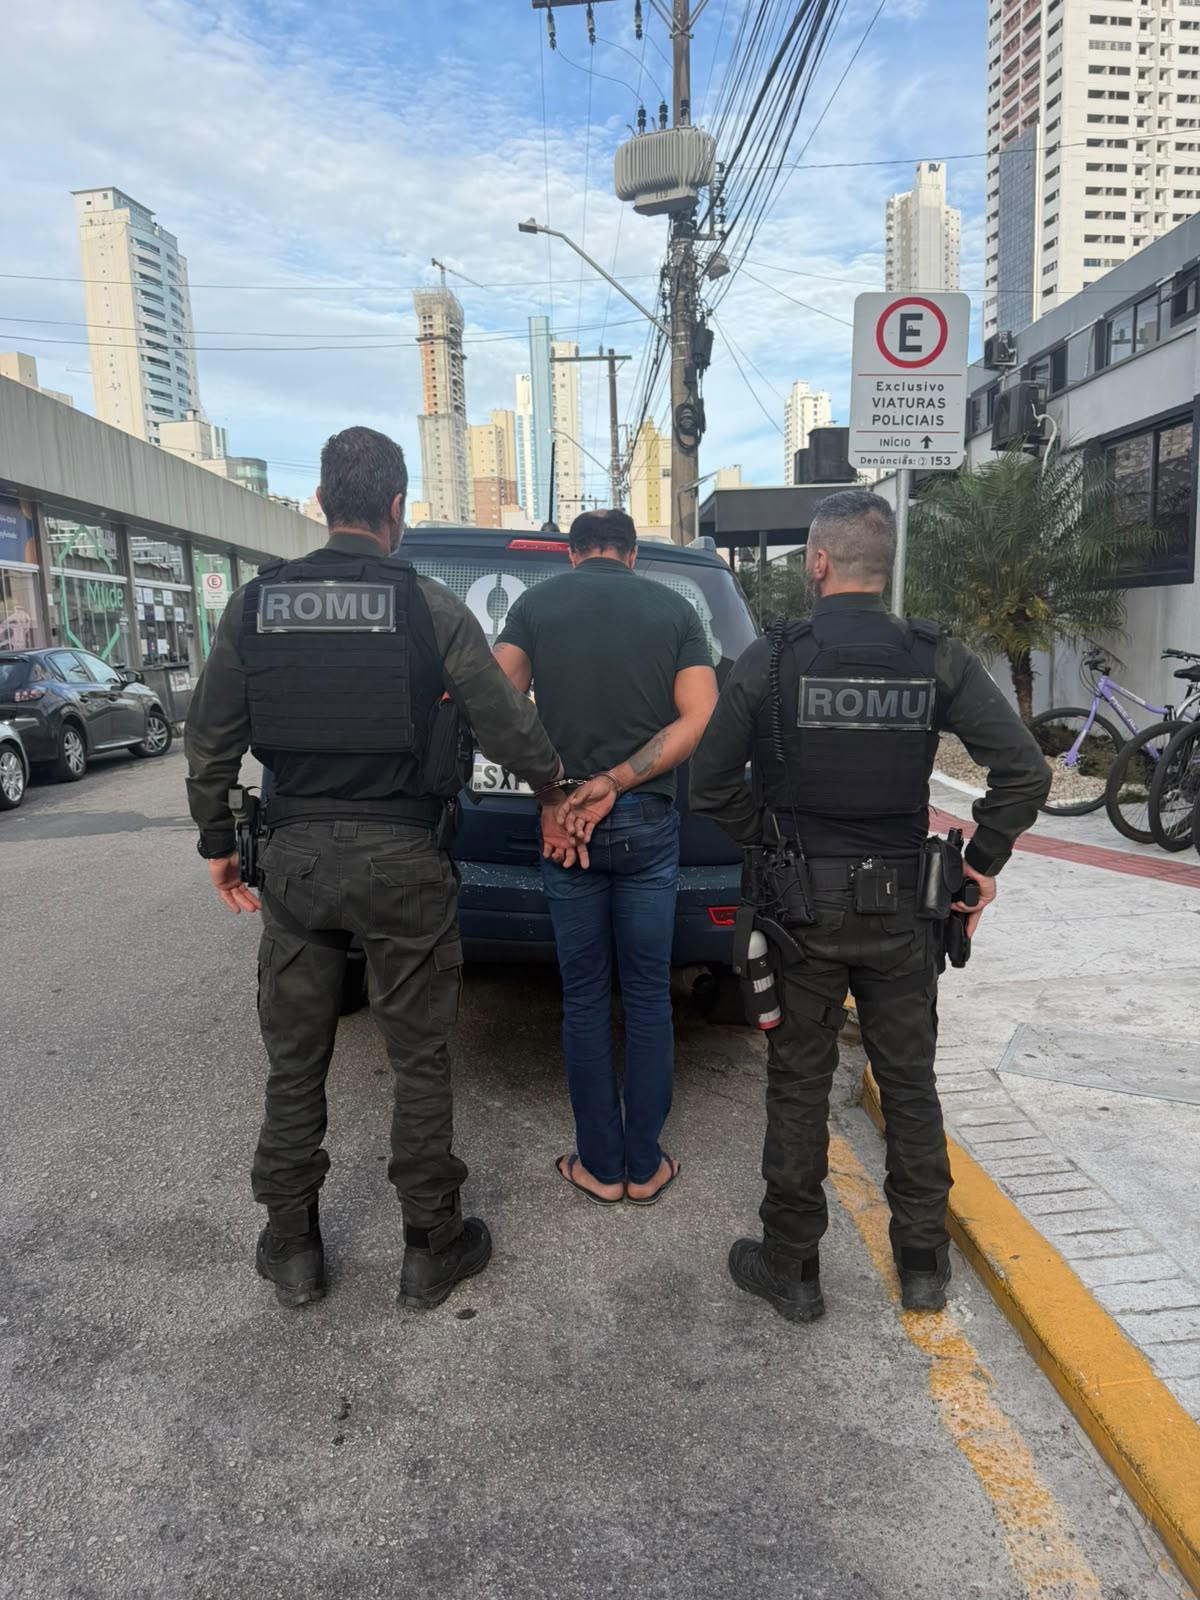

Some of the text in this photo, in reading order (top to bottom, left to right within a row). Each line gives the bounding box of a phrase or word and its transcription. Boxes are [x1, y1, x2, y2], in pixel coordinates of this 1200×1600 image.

[899, 313, 923, 352] E
[876, 381, 945, 393] Exclusivo
[872, 397, 946, 409] VIATURAS
[872, 414, 945, 427] POLICIAIS
[879, 436, 911, 447] INÍCIO
[930, 456, 951, 466] 153
[211, 577, 218, 586] E
[266, 592, 387, 621] ROMU
[807, 687, 927, 719] ROMU
